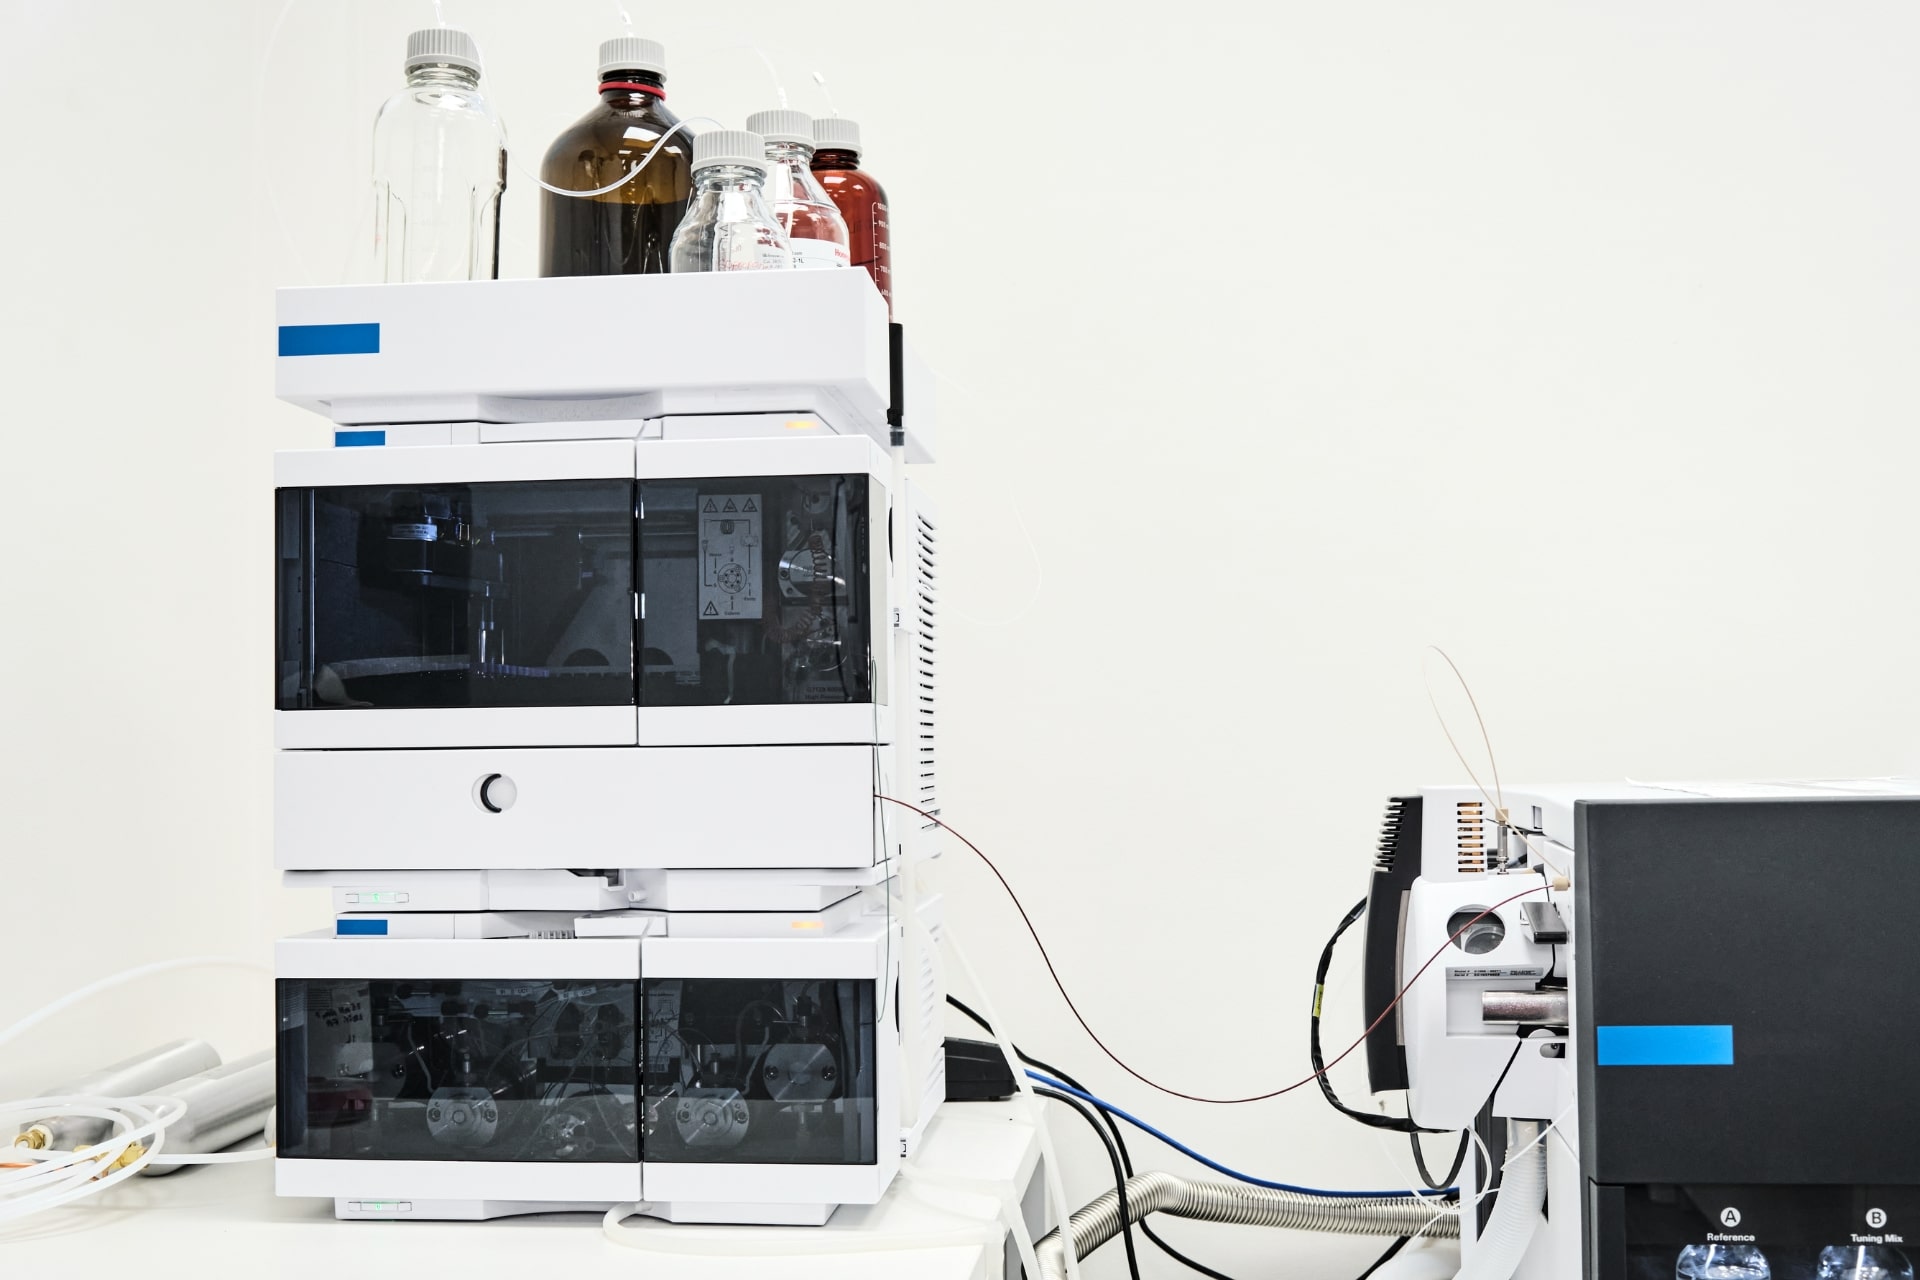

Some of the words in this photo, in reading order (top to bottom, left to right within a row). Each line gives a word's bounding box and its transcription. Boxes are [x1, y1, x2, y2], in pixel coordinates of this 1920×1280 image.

[1724, 1210, 1737, 1223] A
[1871, 1211, 1882, 1224] B
[1707, 1232, 1756, 1242] Reference
[1850, 1233, 1883, 1244] Tuning
[1884, 1234, 1903, 1243] Mix
